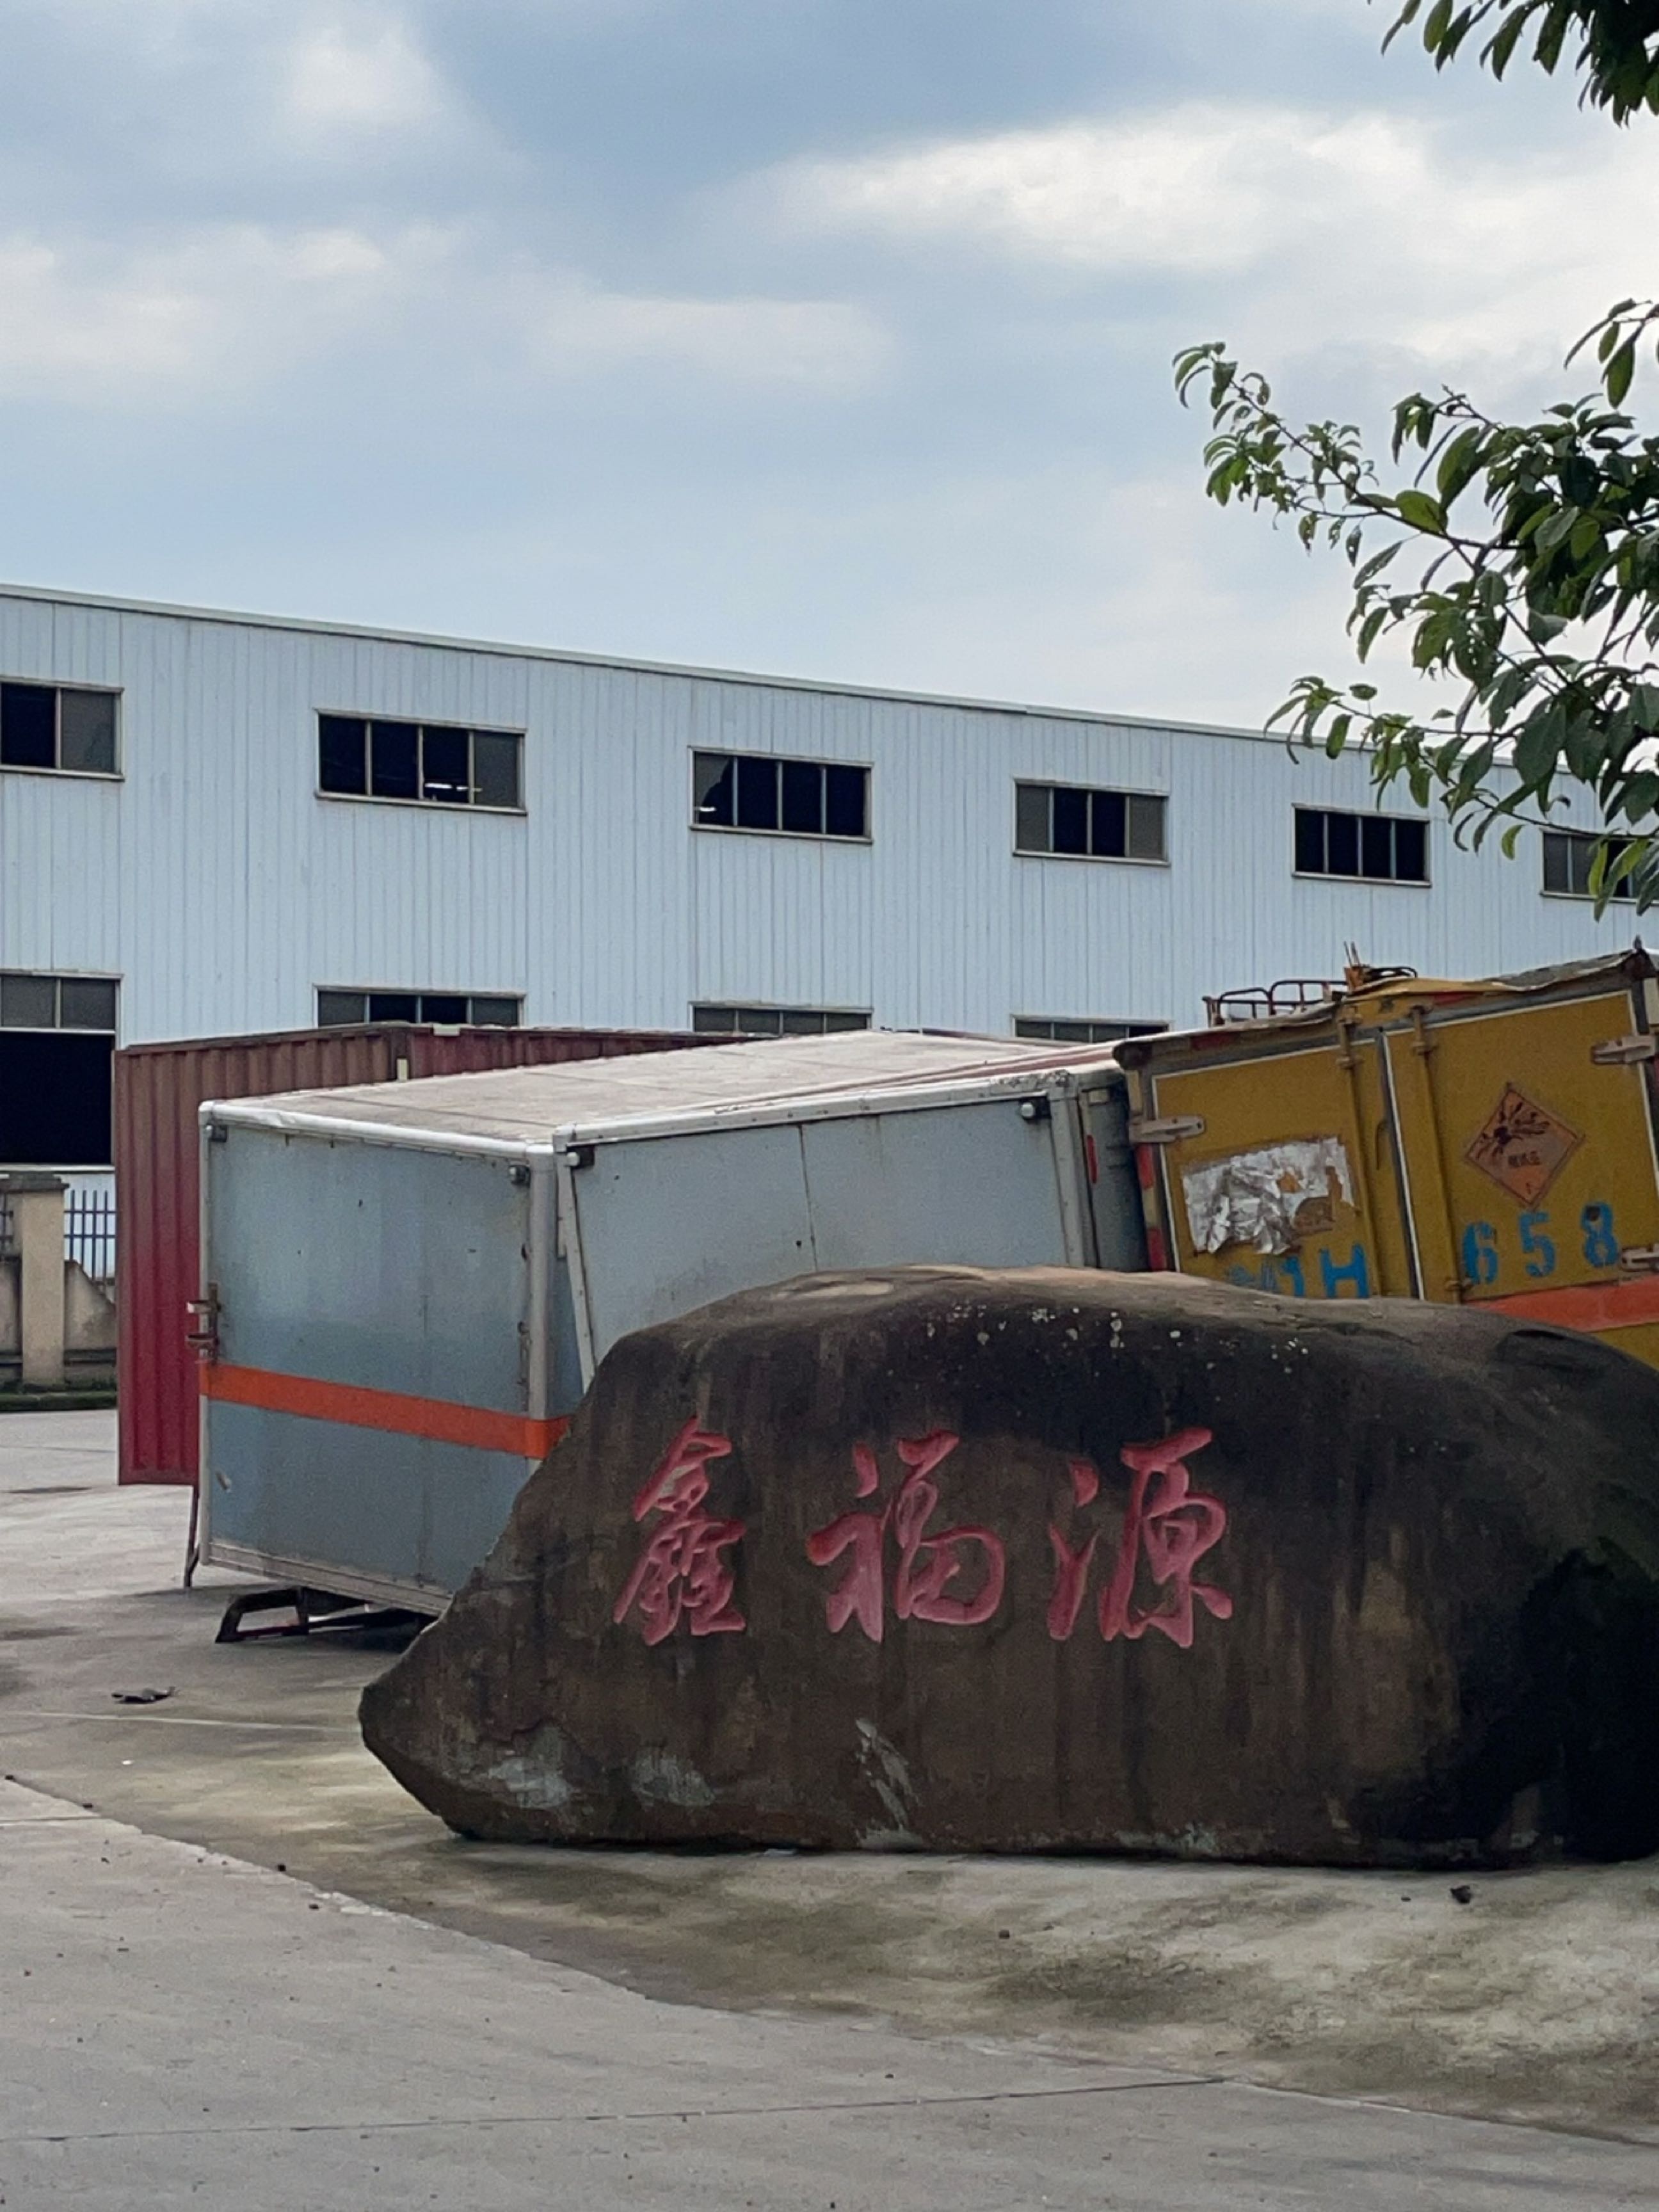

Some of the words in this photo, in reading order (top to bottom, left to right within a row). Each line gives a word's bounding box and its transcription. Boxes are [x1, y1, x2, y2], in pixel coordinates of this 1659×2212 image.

[1462, 1199, 1619, 1285] 658
[614, 1416, 1233, 1647] 鑫福源
